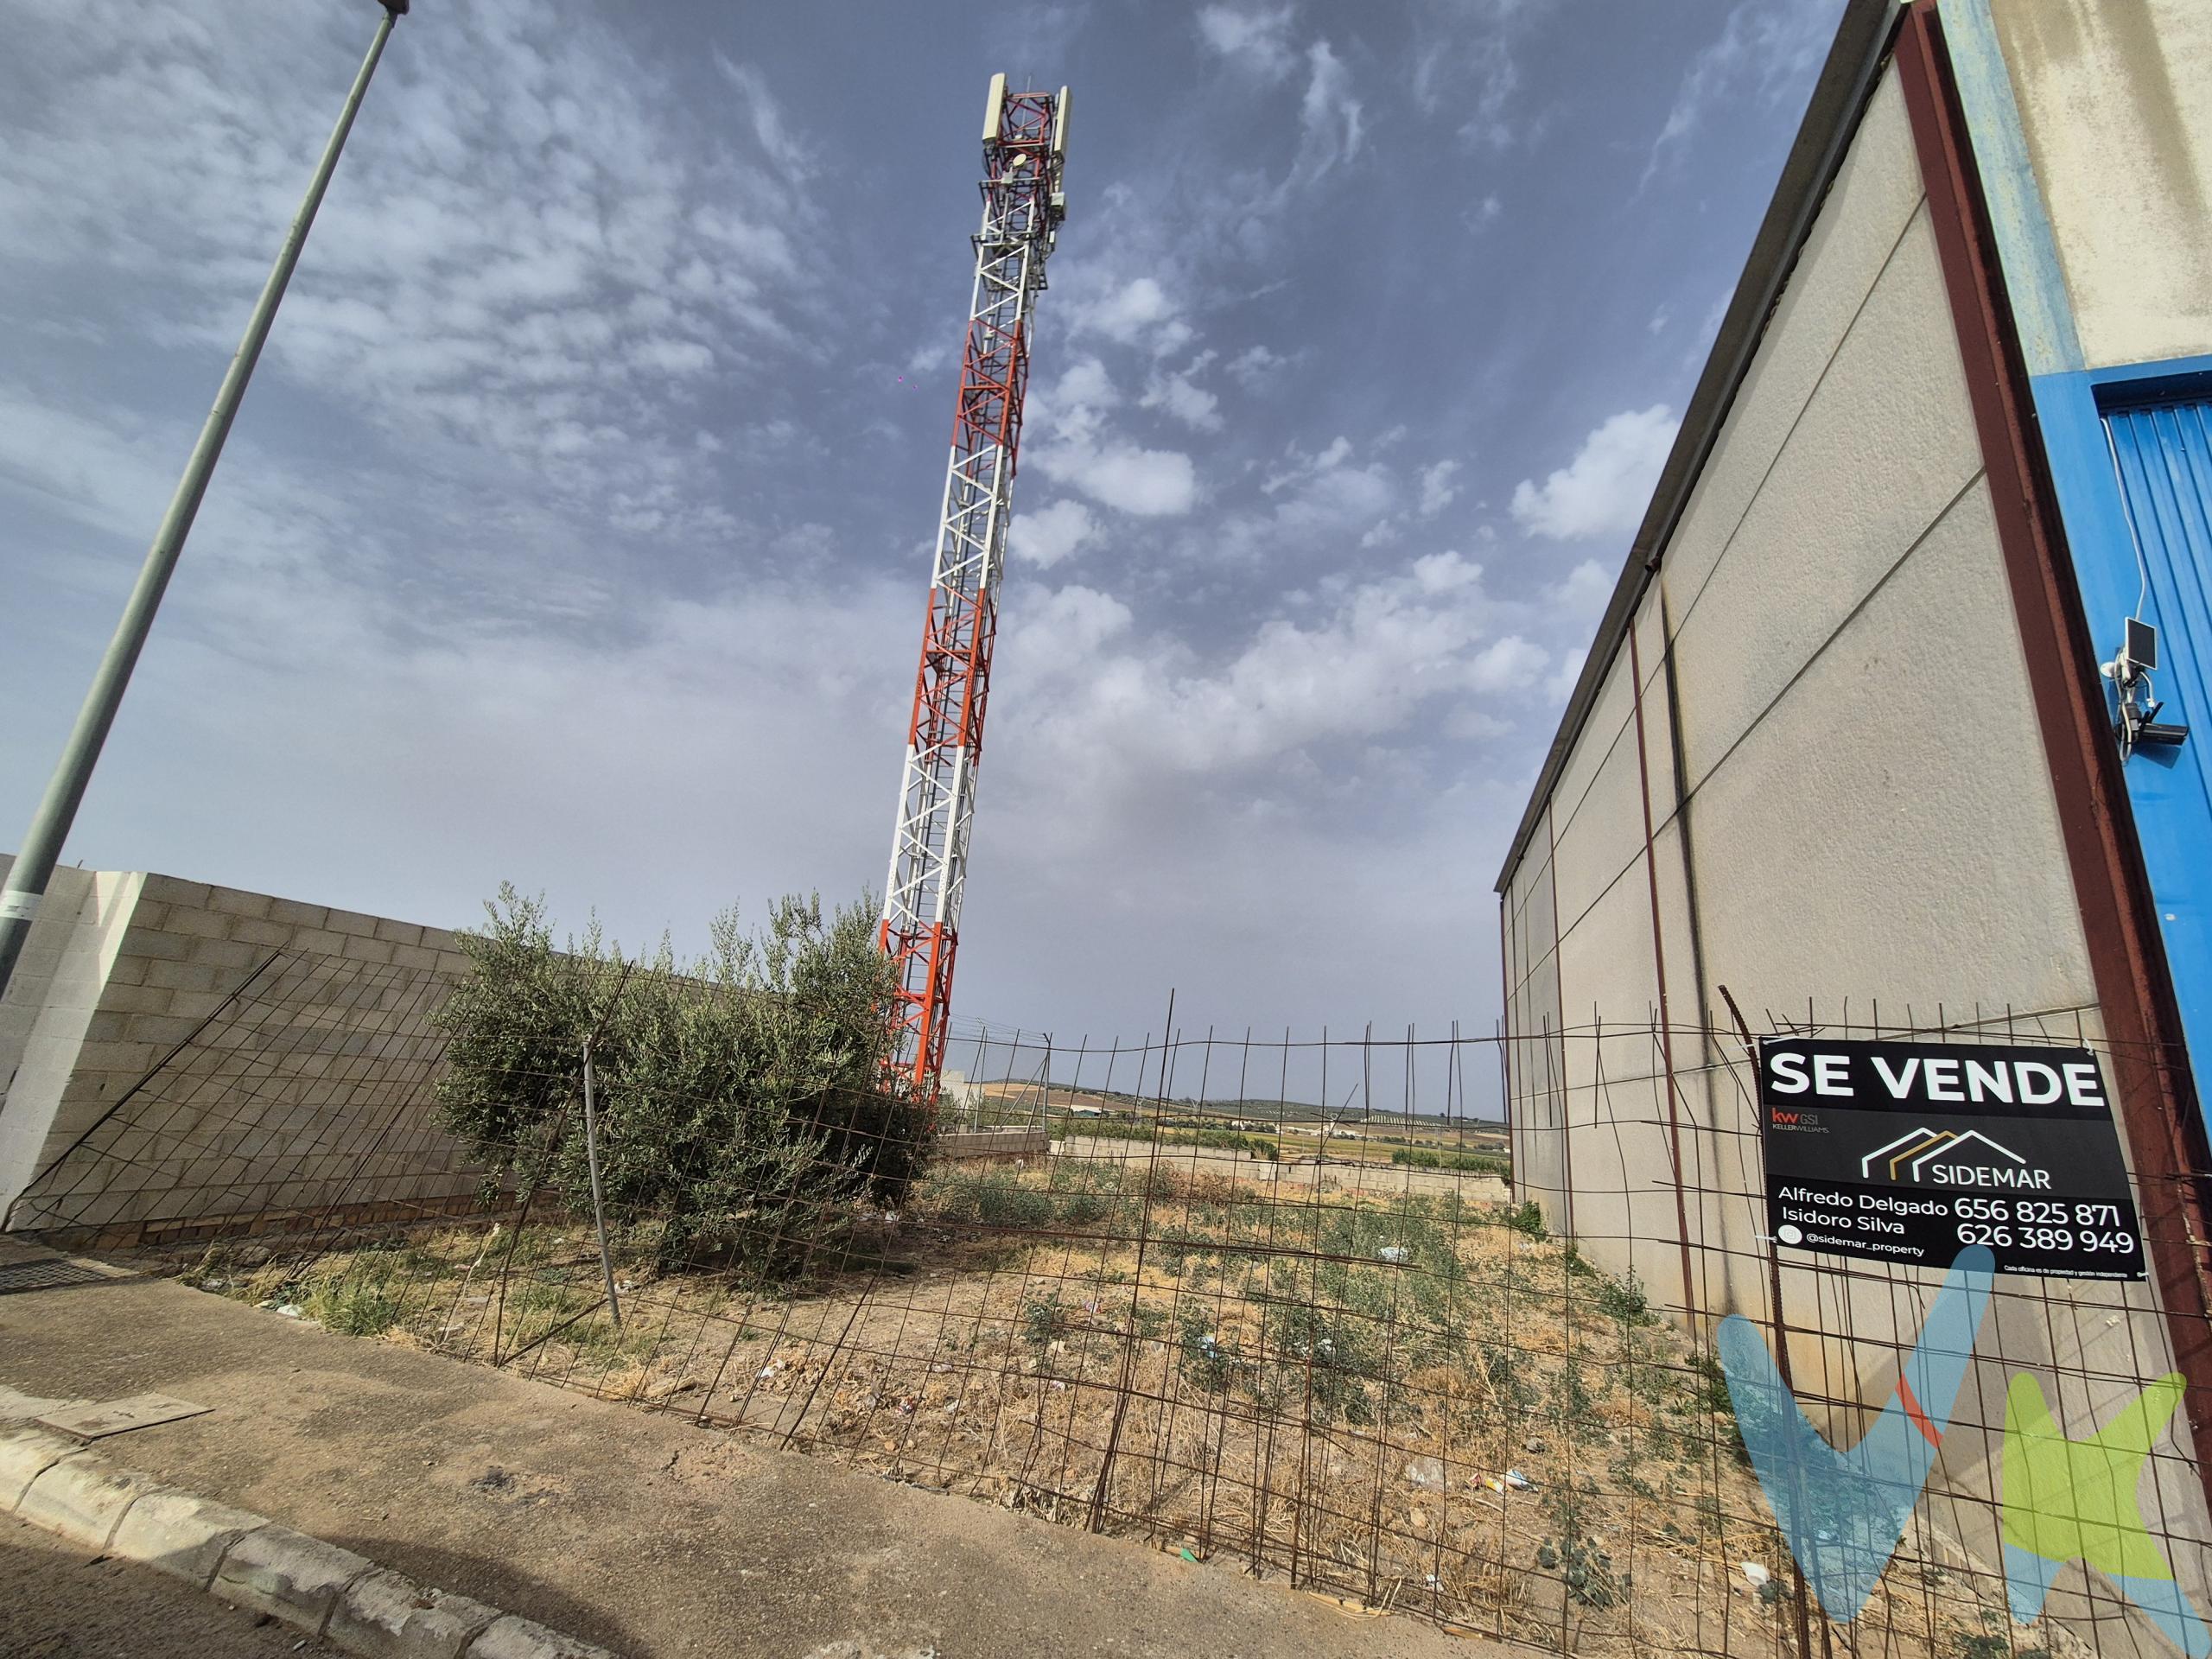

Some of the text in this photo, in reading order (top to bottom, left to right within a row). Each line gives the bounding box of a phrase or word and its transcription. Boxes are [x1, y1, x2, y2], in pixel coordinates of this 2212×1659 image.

[1770, 1052, 2105, 1107] SE VENDE
[1771, 1107, 1799, 1123] kw
[1932, 1164, 2052, 1190] SIDEMAR
[1778, 1186, 2120, 1227] Alfredo Delgado 656 825 871
[1783, 1206, 2134, 1254] Isidoro Silva 626 389 949
[1806, 1233, 1924, 1257] @sidemar_property
